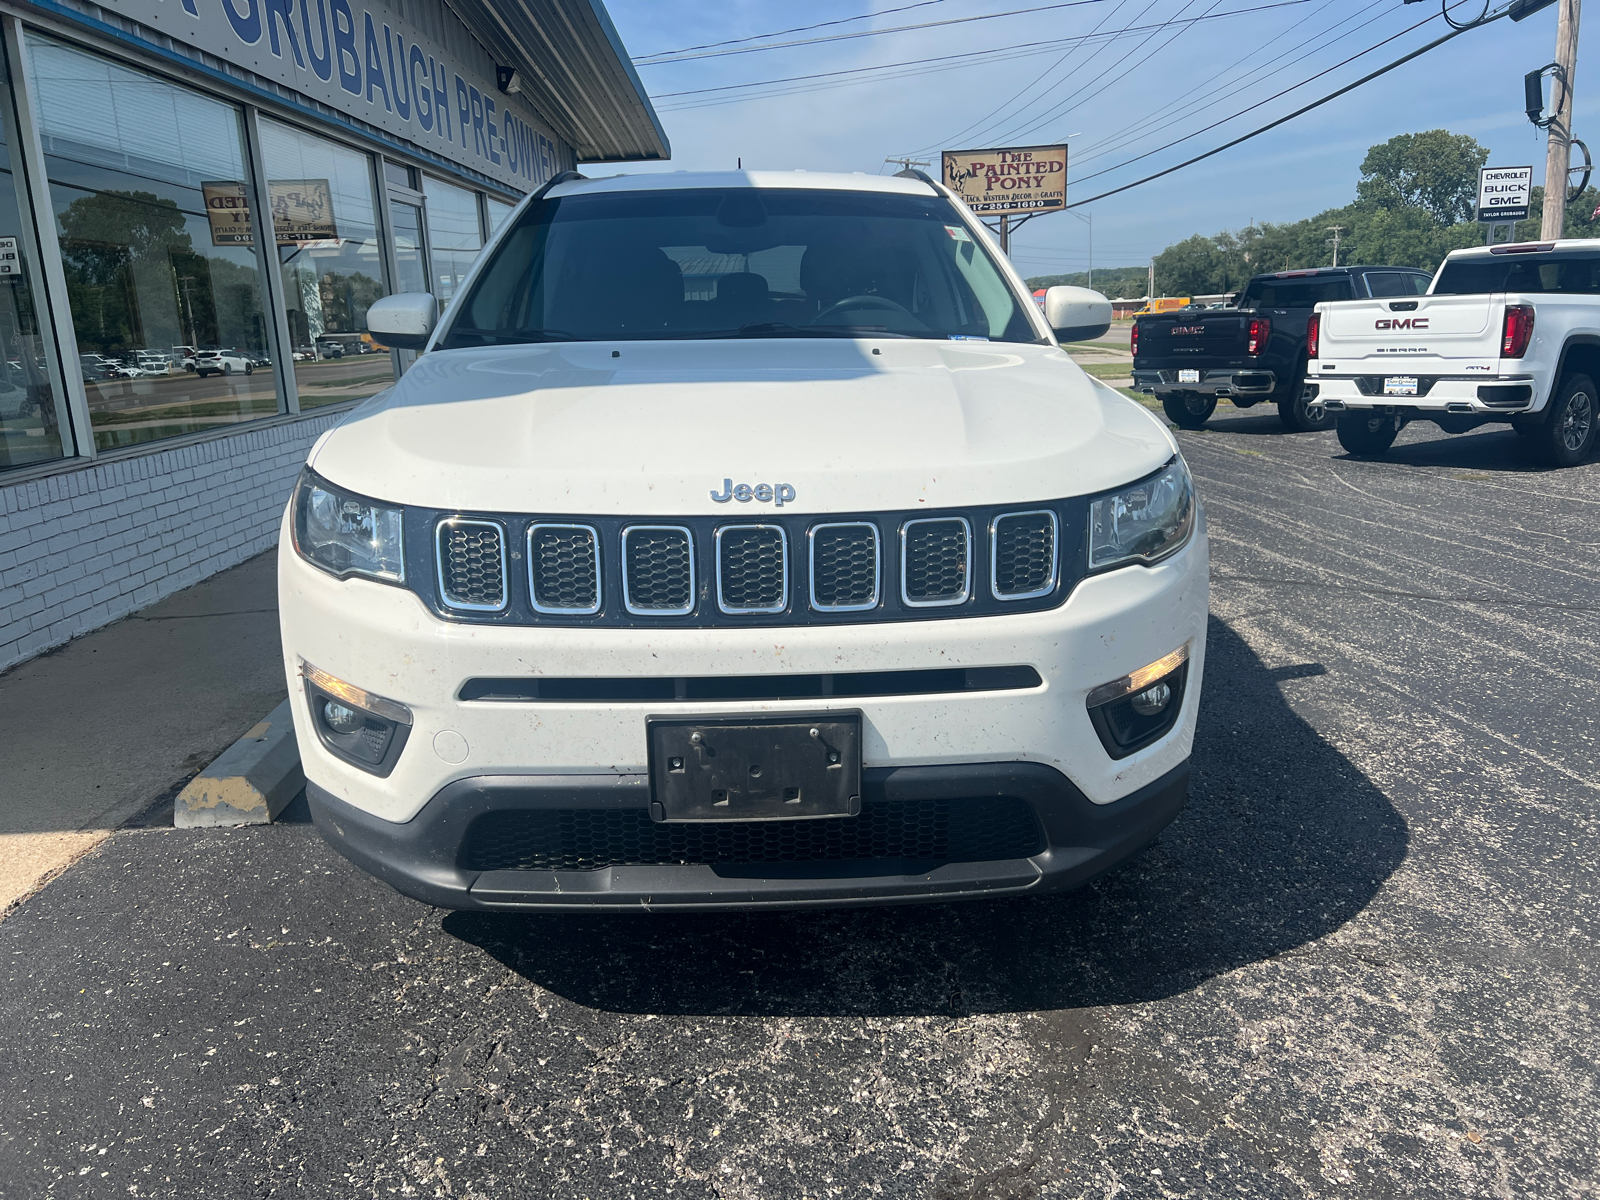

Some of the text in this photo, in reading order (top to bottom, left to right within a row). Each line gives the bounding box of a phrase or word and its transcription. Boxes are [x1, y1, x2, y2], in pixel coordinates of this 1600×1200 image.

[455, 72, 558, 185] PRE-OWNED
[997, 151, 1033, 164] THE
[970, 161, 1064, 178] PAINTED
[1486, 172, 1528, 180] CHEVROLET
[985, 175, 1046, 192] PONY
[1485, 184, 1527, 193] BUICK
[983, 191, 1010, 202] WESTERN
[1011, 192, 1032, 202] DECOR
[1489, 197, 1521, 205] GMC
[1375, 318, 1430, 331] GMC
[709, 478, 796, 507] Jeep
